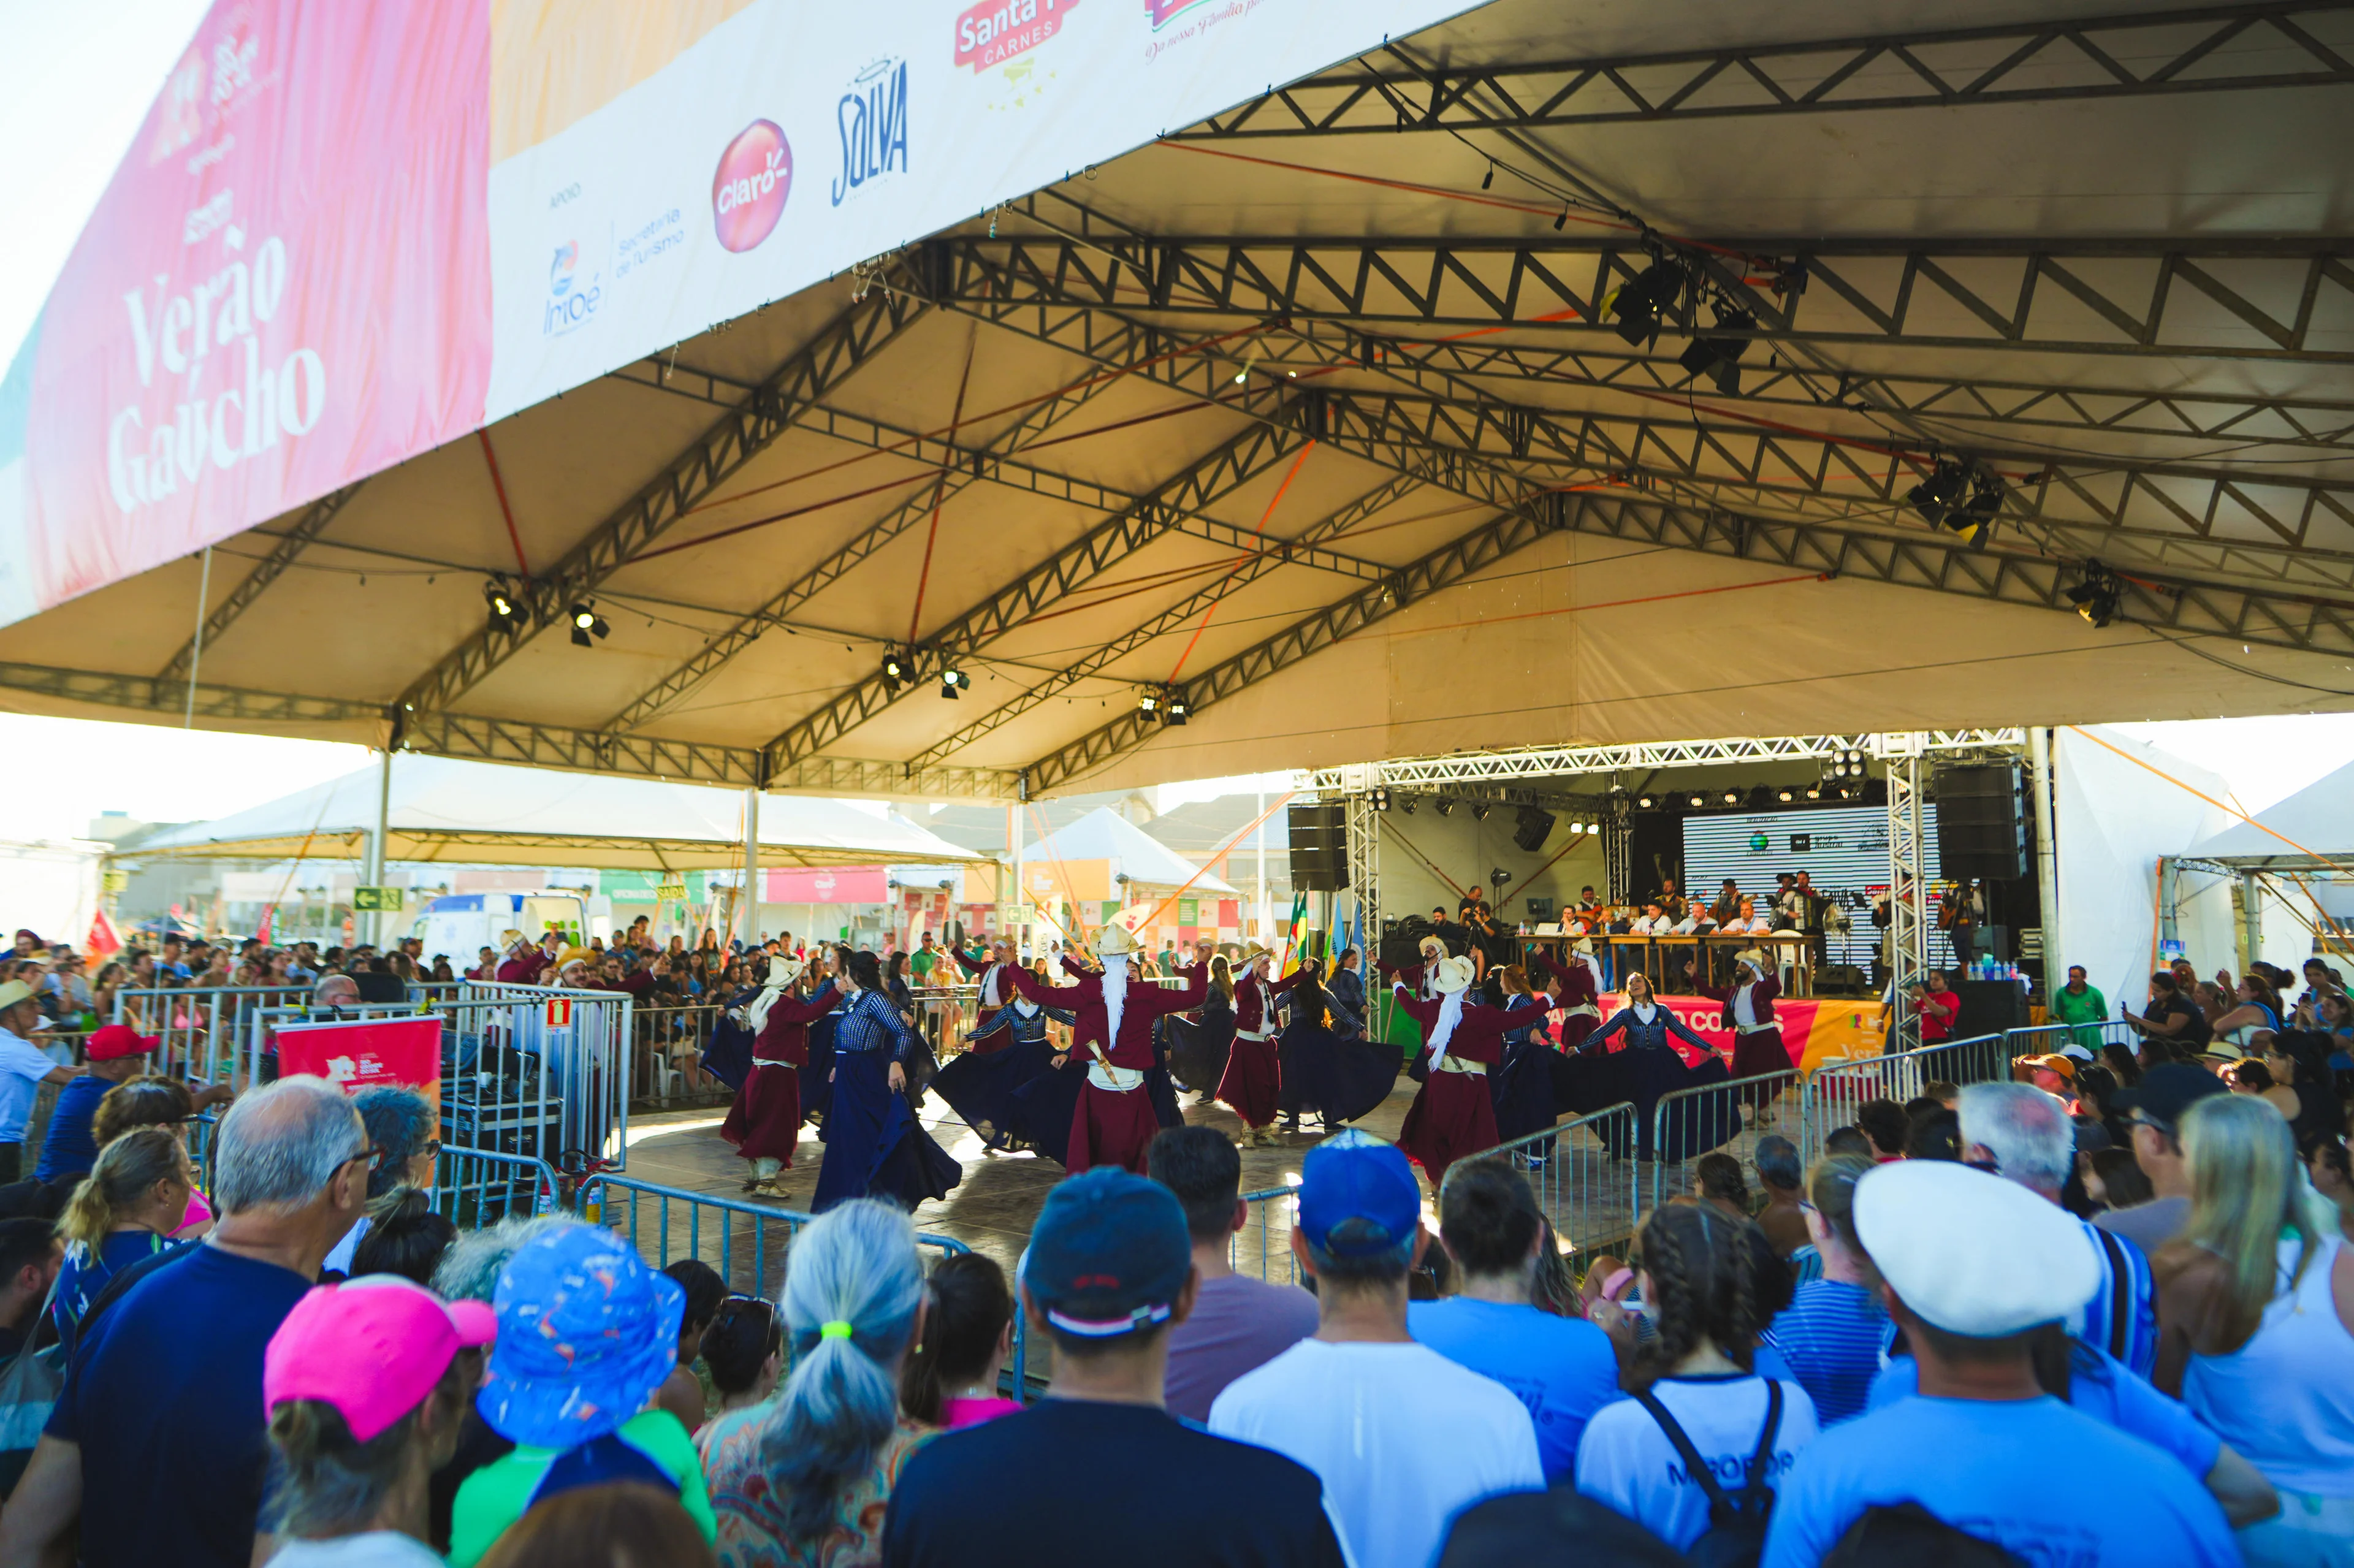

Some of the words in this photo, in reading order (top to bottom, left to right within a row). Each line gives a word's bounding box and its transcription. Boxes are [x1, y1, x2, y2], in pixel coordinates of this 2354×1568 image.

[959, 0, 1037, 53] Santa
[985, 21, 1053, 64] CARNES
[1167, 26, 1195, 48] nossa
[831, 59, 907, 208] SOLVA
[123, 224, 287, 388] Verão
[107, 334, 326, 514] Gaúcho
